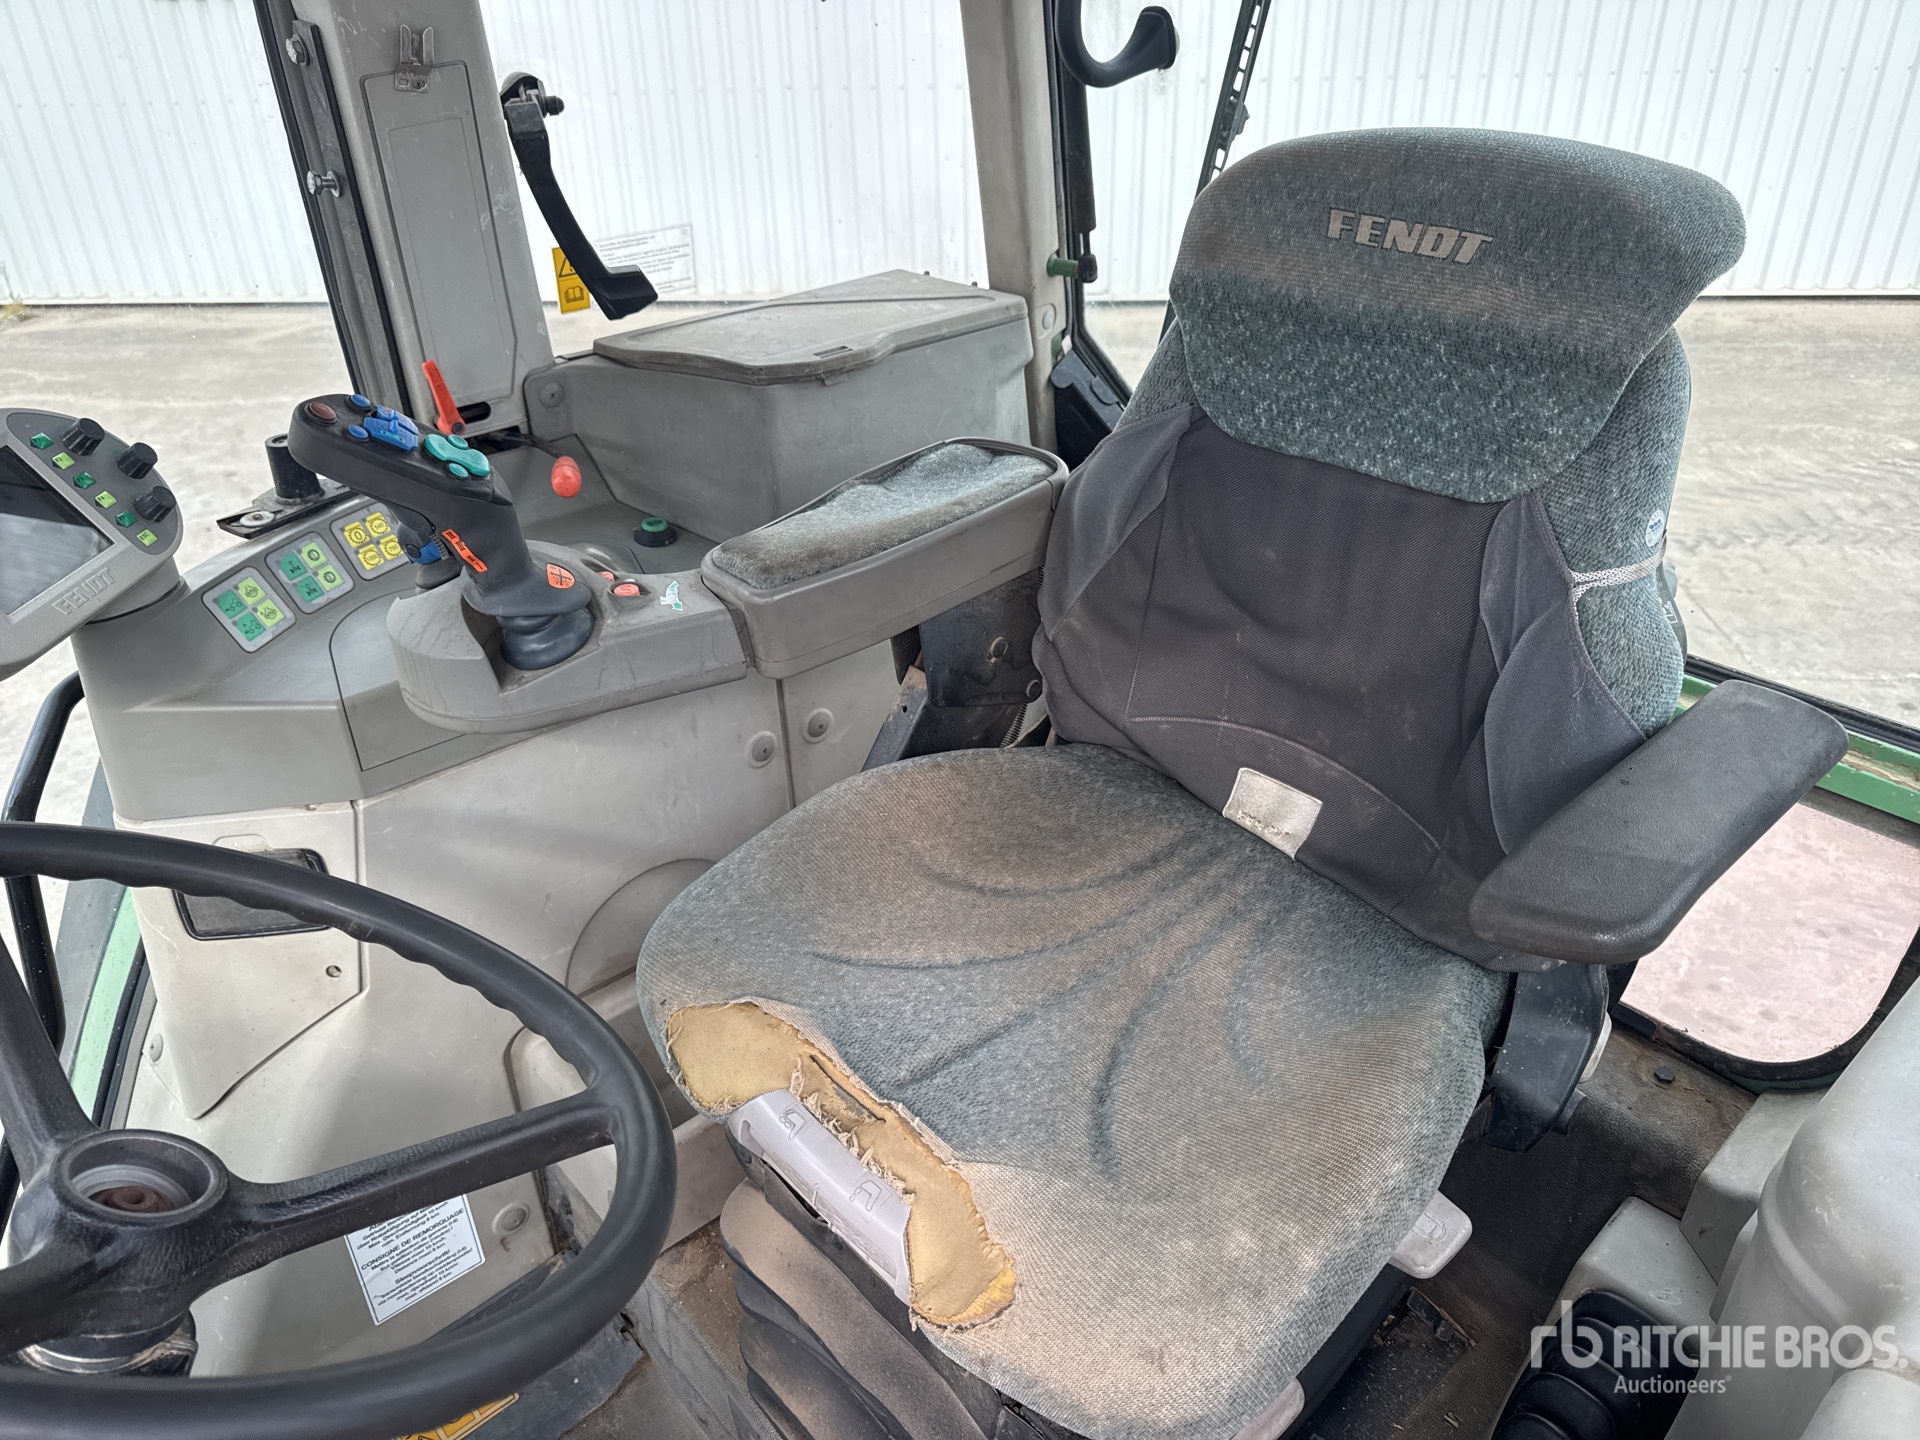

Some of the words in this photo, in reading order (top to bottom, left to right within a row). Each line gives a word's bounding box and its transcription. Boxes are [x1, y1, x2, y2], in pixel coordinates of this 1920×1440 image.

[1327, 208, 1494, 265] FENDT
[139, 531, 150, 541] ESC
[51, 567, 114, 615] FENDT
[361, 1245, 400, 1270] CONSIGNE
[401, 1238, 411, 1247] DE
[412, 1208, 464, 1241] REMORQUAGE
